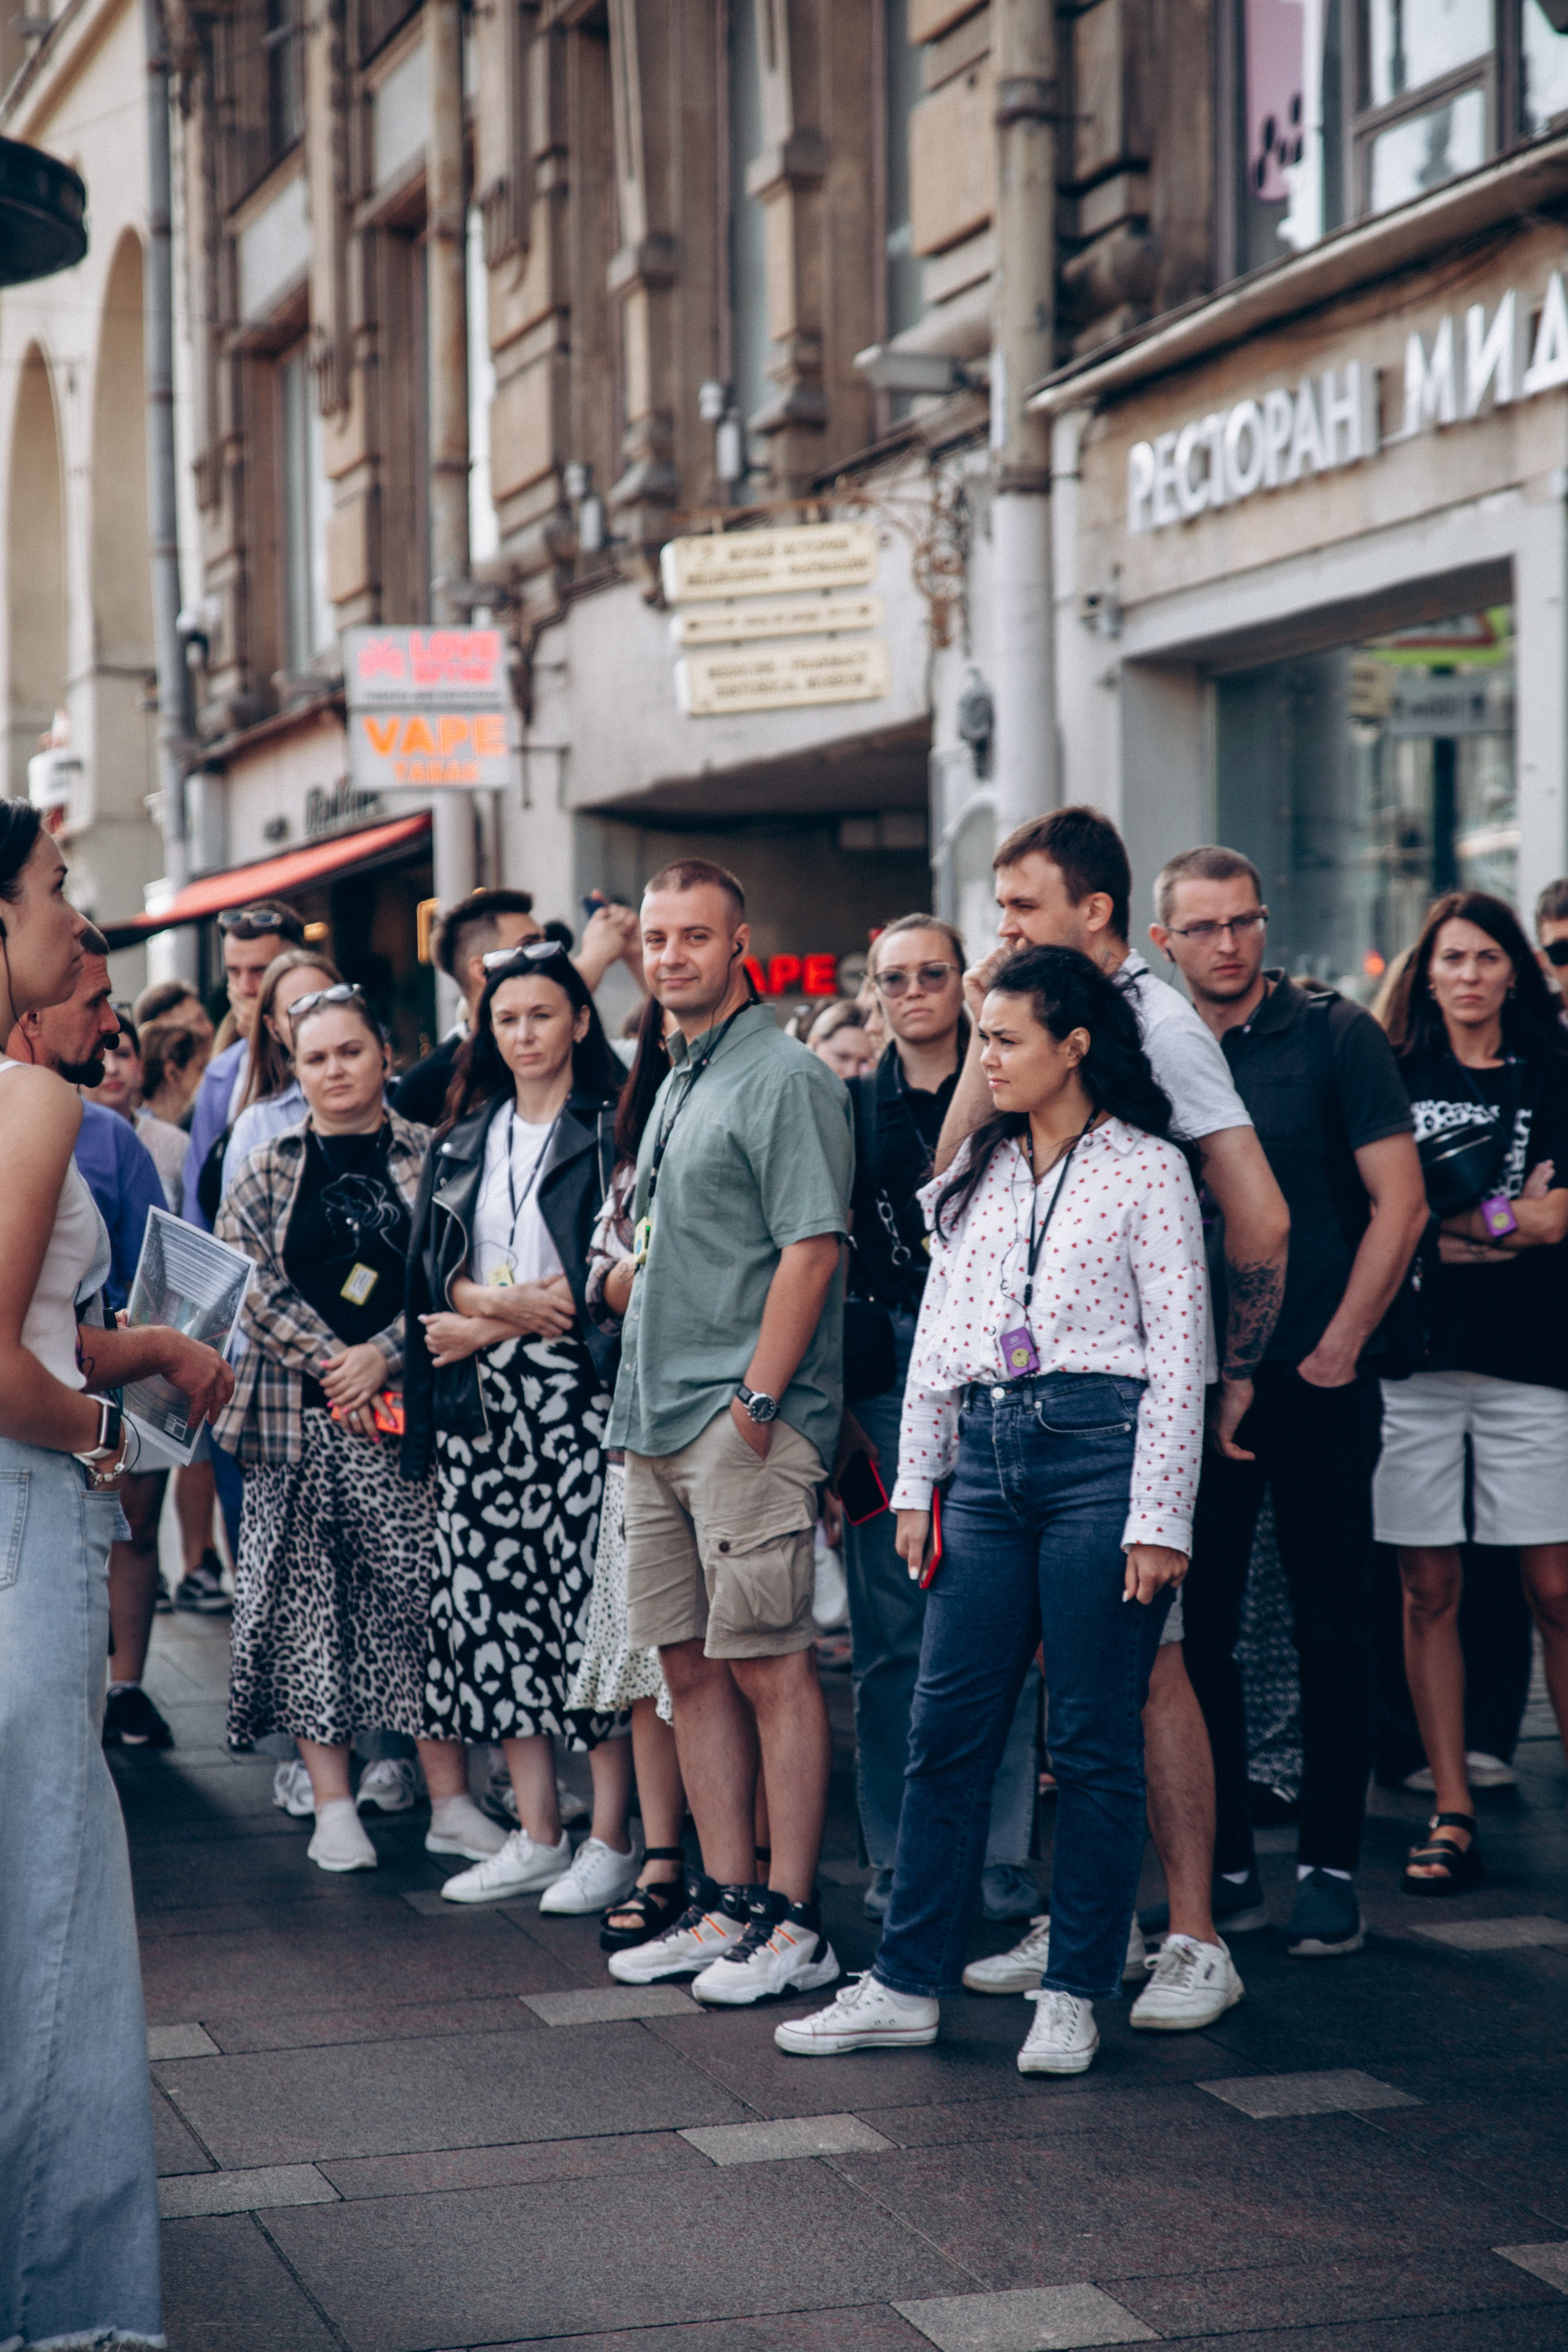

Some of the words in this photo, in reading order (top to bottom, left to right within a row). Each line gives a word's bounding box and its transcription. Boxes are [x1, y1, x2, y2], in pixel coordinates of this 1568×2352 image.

[1127, 359, 1362, 534] РЕСТОРАН
[1404, 270, 1568, 432] МИД
[361, 714, 508, 756] VAPE
